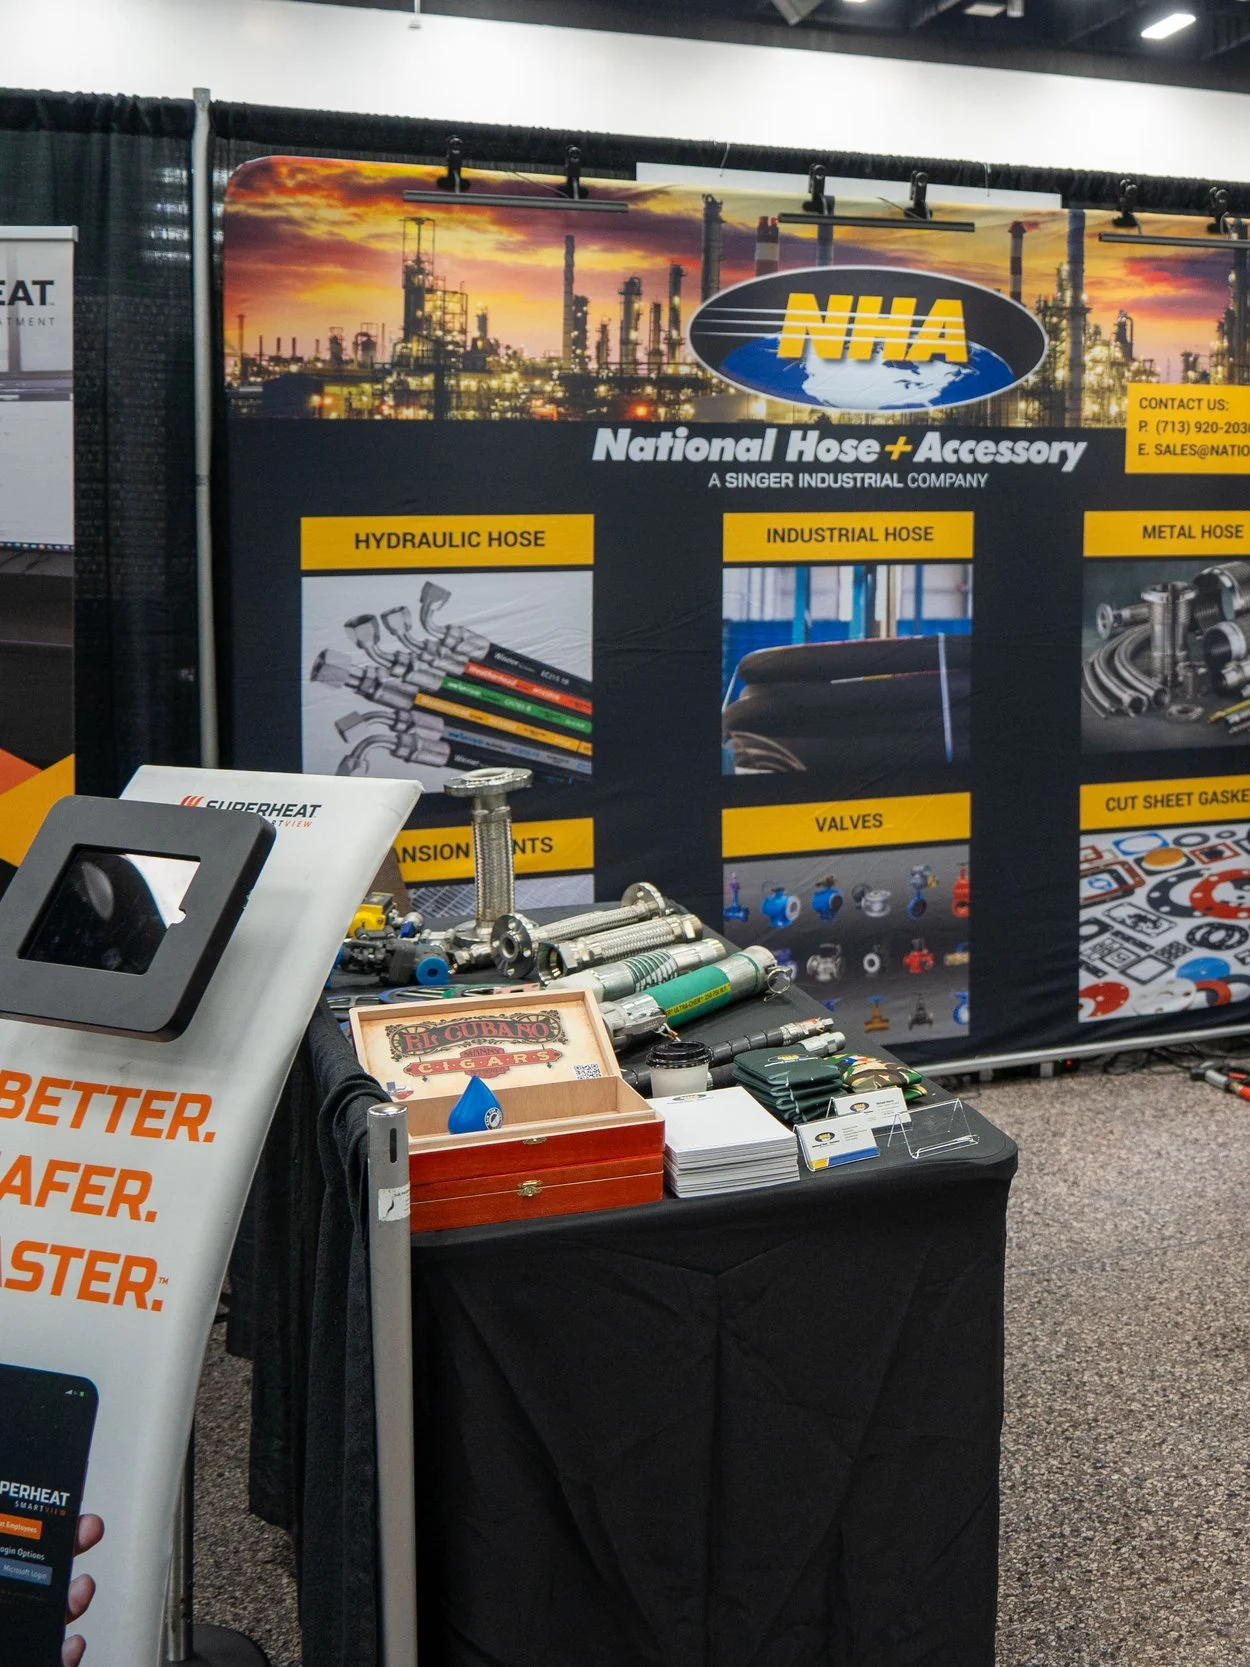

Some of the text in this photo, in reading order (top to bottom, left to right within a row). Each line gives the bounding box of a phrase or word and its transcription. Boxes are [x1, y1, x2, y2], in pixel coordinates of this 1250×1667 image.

[777, 292, 969, 363] NHA
[1139, 396, 1230, 412] CONTACT US:
[1156, 420, 1190, 436] (713)
[592, 428, 775, 464] National
[1138, 443, 1150, 456] E.
[708, 473, 989, 489] A SINGER INDUSTRIAL COMPANY
[354, 530, 546, 550] HYDRAULIC HOSE
[766, 525, 934, 545] INDUSTRIAL HOSE
[1142, 523, 1245, 540] METAL HOSE
[1105, 796, 1138, 813] CUT
[1143, 792, 1194, 811] SHEET
[815, 811, 884, 834] VALVES
[396, 837, 554, 865] NSION NTS
[444, 1020, 550, 1041] CUBANO
[0, 1069, 216, 1143] BETTER.
[0, 1154, 158, 1223] AFER.
[6, 1521, 37, 1534] Employees
[0, 1546, 45, 1561] ogin Options
[3, 1564, 48, 1581] Microsoft Login
